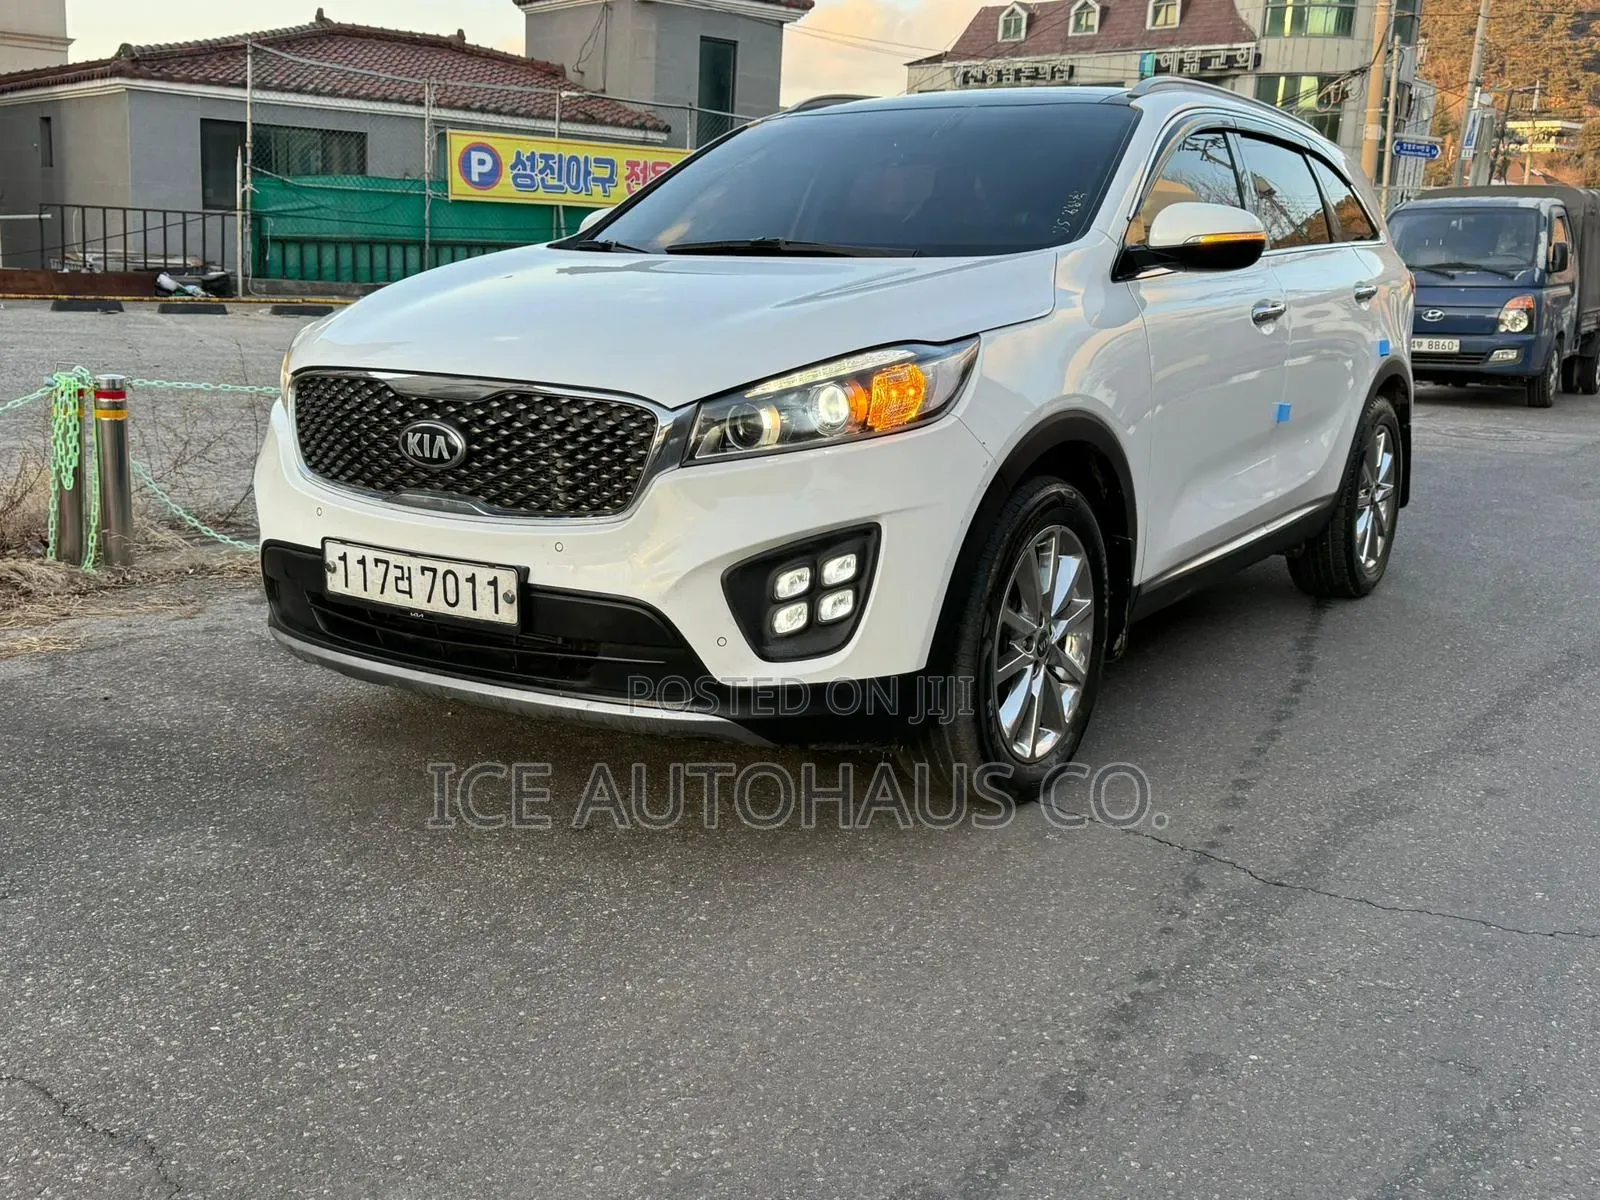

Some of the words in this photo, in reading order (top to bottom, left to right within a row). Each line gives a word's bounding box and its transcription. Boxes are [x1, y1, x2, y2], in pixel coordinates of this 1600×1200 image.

[470, 150, 493, 183] P
[509, 148, 618, 196] 성진아구
[624, 159, 673, 195] 전
[1427, 340, 1454, 351] 8860
[407, 432, 451, 460] KIA
[337, 551, 500, 615] 117러7011
